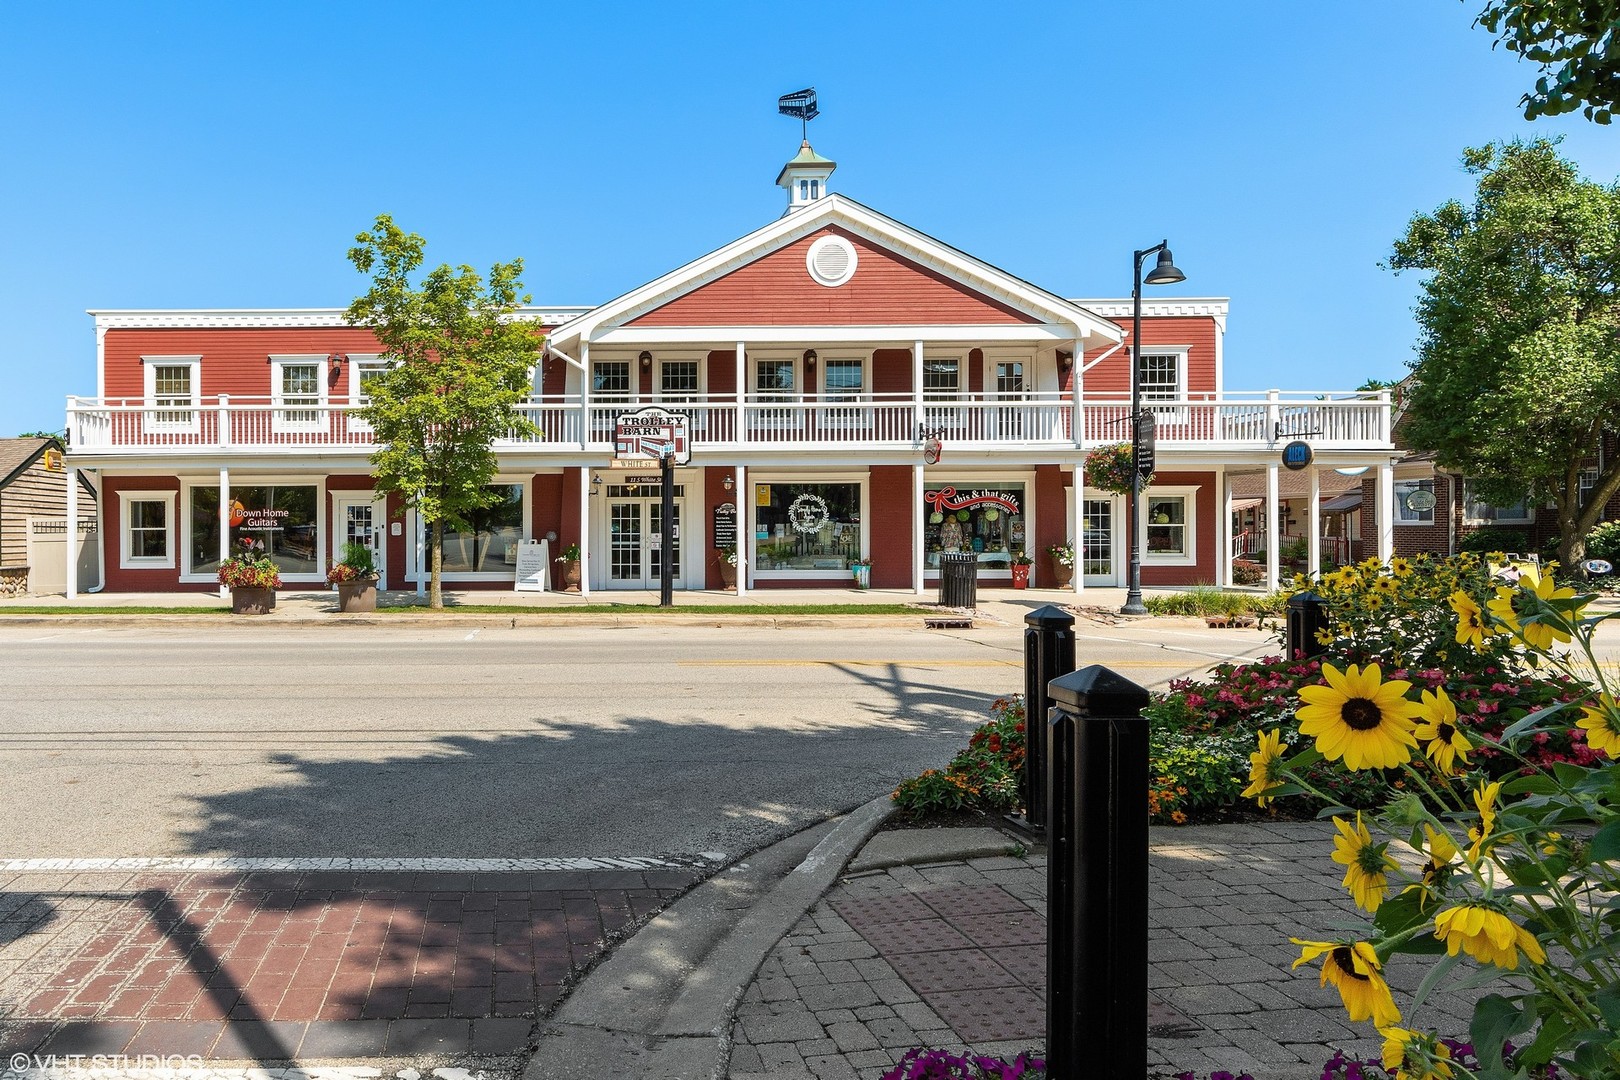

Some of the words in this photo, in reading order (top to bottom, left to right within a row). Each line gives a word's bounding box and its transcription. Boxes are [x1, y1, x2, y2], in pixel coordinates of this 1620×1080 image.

[622, 416, 684, 426] TROLLEY
[622, 428, 661, 436] BARN
[954, 493, 970, 504] this
[972, 490, 980, 498] &
[981, 488, 998, 498] that
[1000, 493, 1020, 506] gifts
[236, 509, 262, 517] Down
[263, 508, 289, 517] Home
[982, 502, 1010, 514] accessories
[248, 518, 278, 526] Guitars
